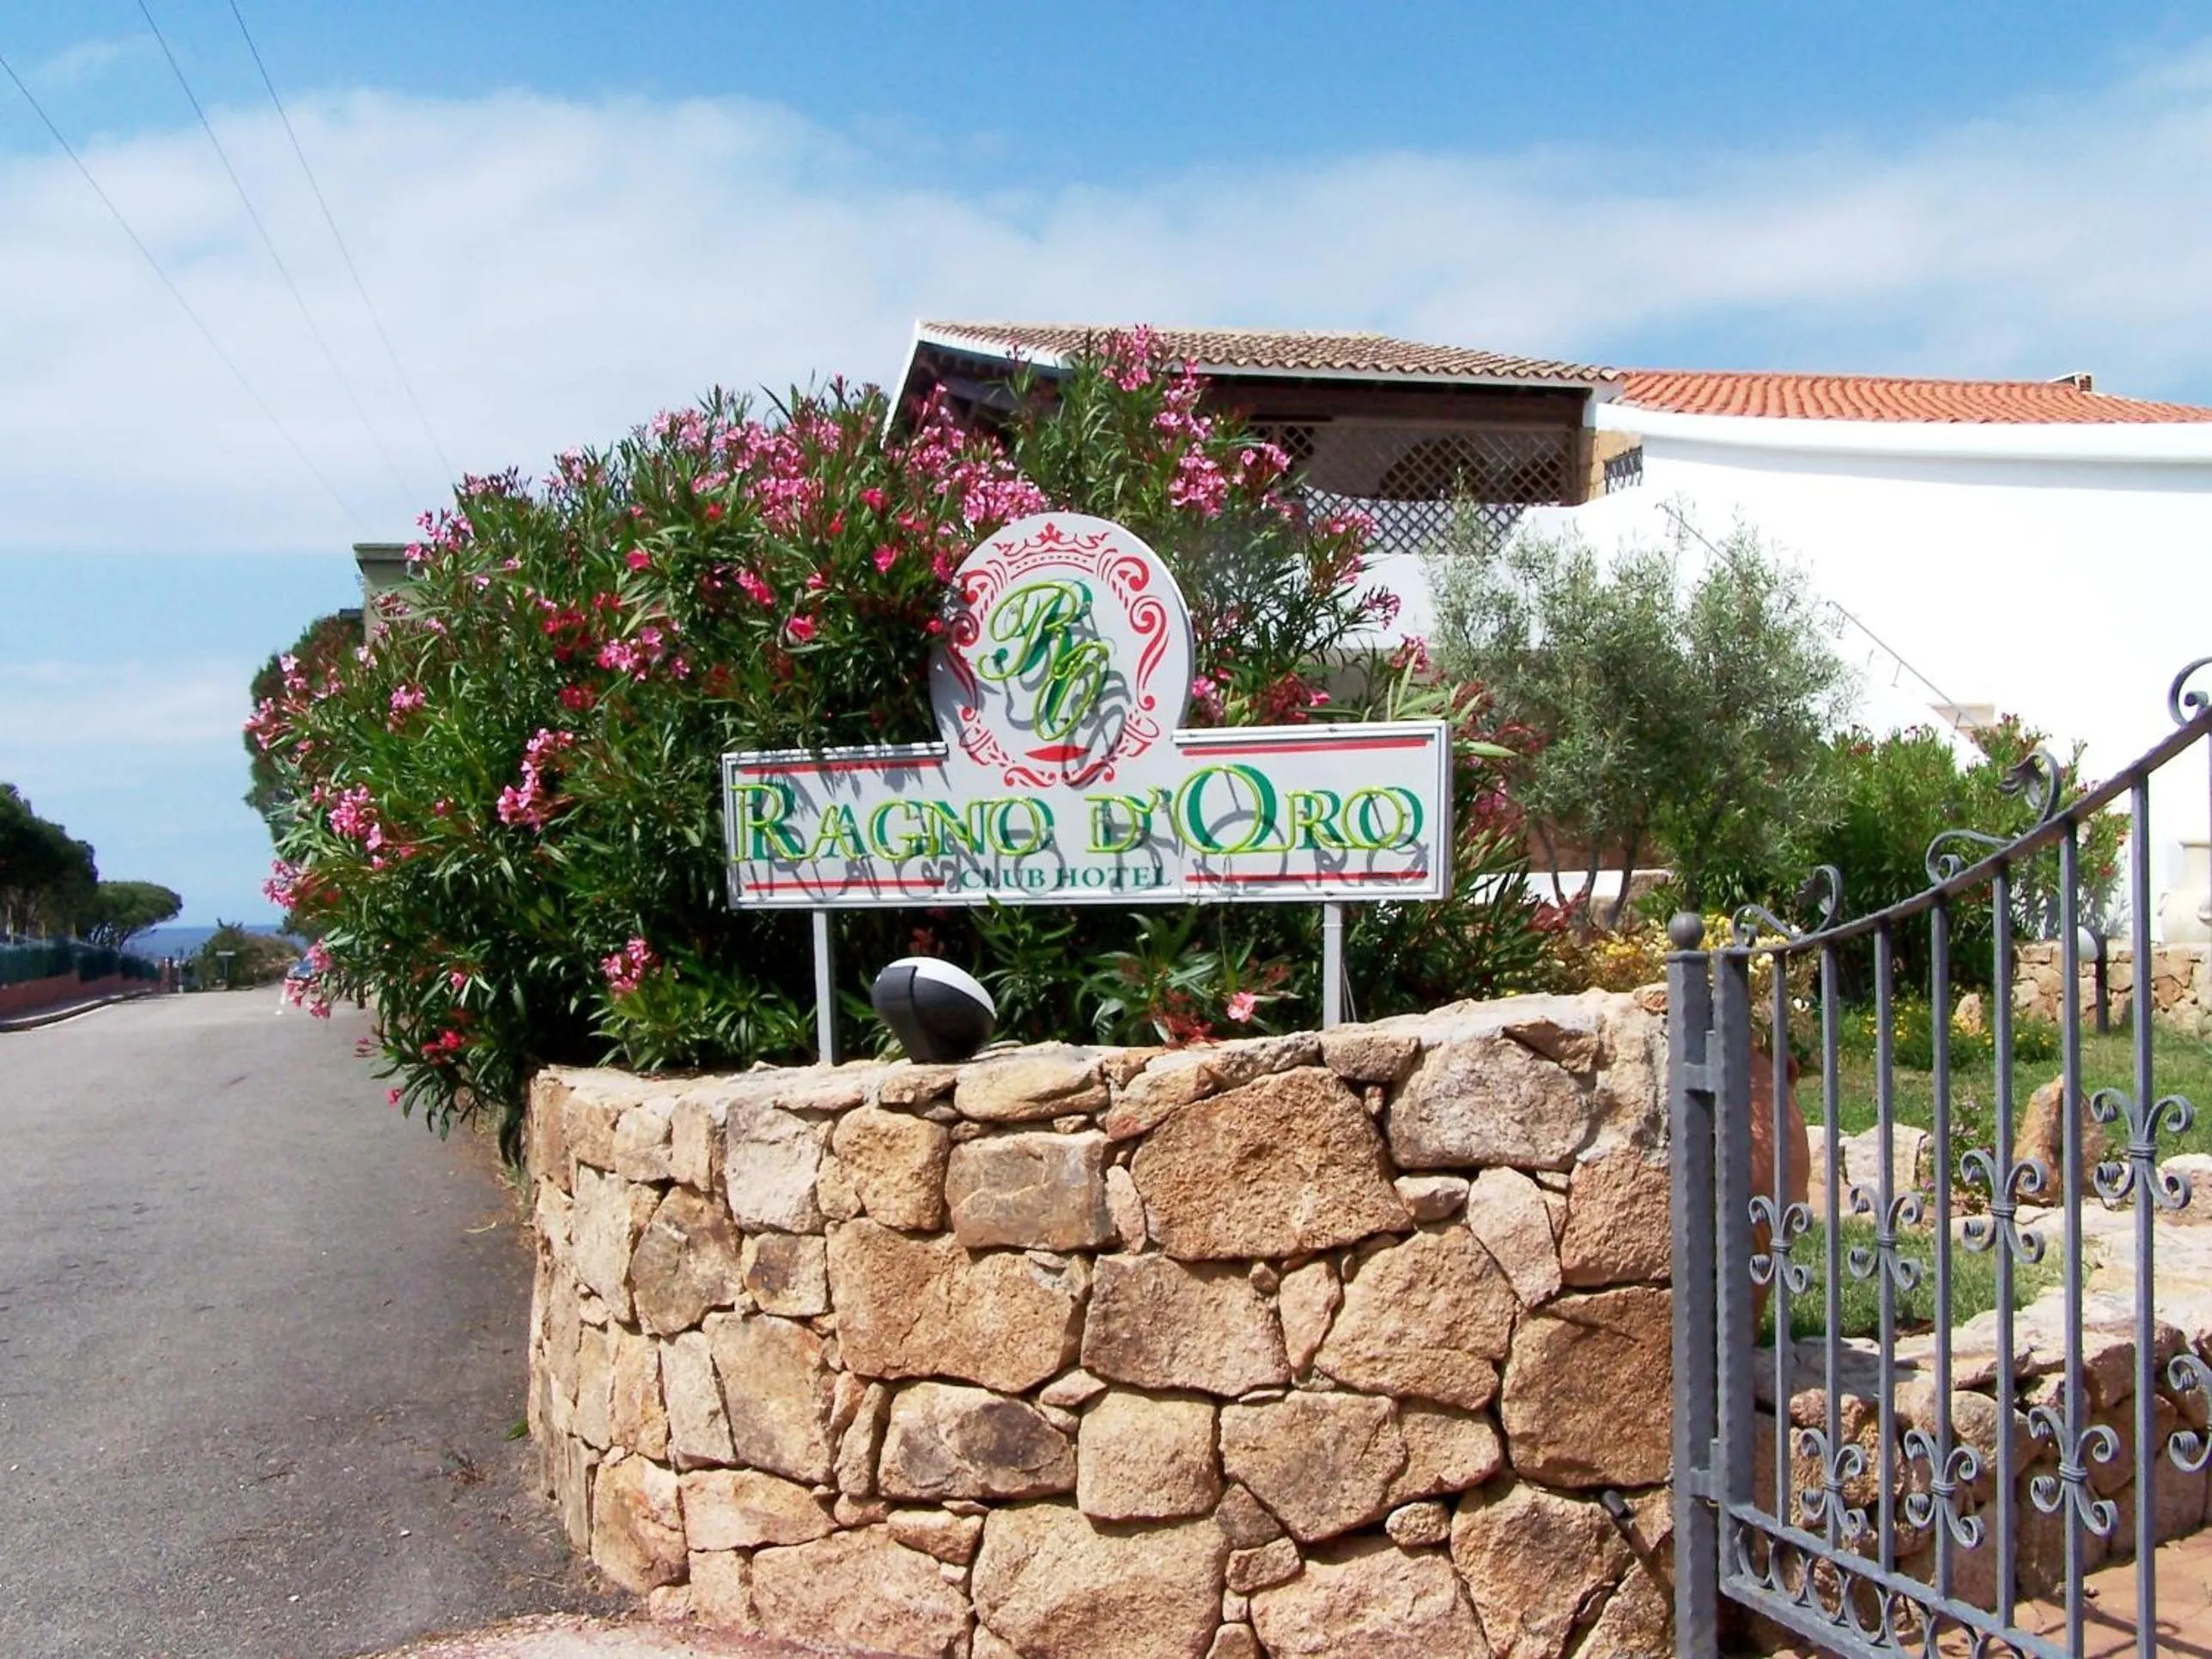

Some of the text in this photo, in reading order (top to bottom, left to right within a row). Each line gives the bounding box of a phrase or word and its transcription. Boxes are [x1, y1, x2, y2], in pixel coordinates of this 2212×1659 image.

[730, 763, 1424, 862] RAGNO D'ORO
[959, 866, 1172, 890] CLUB HOTEL
